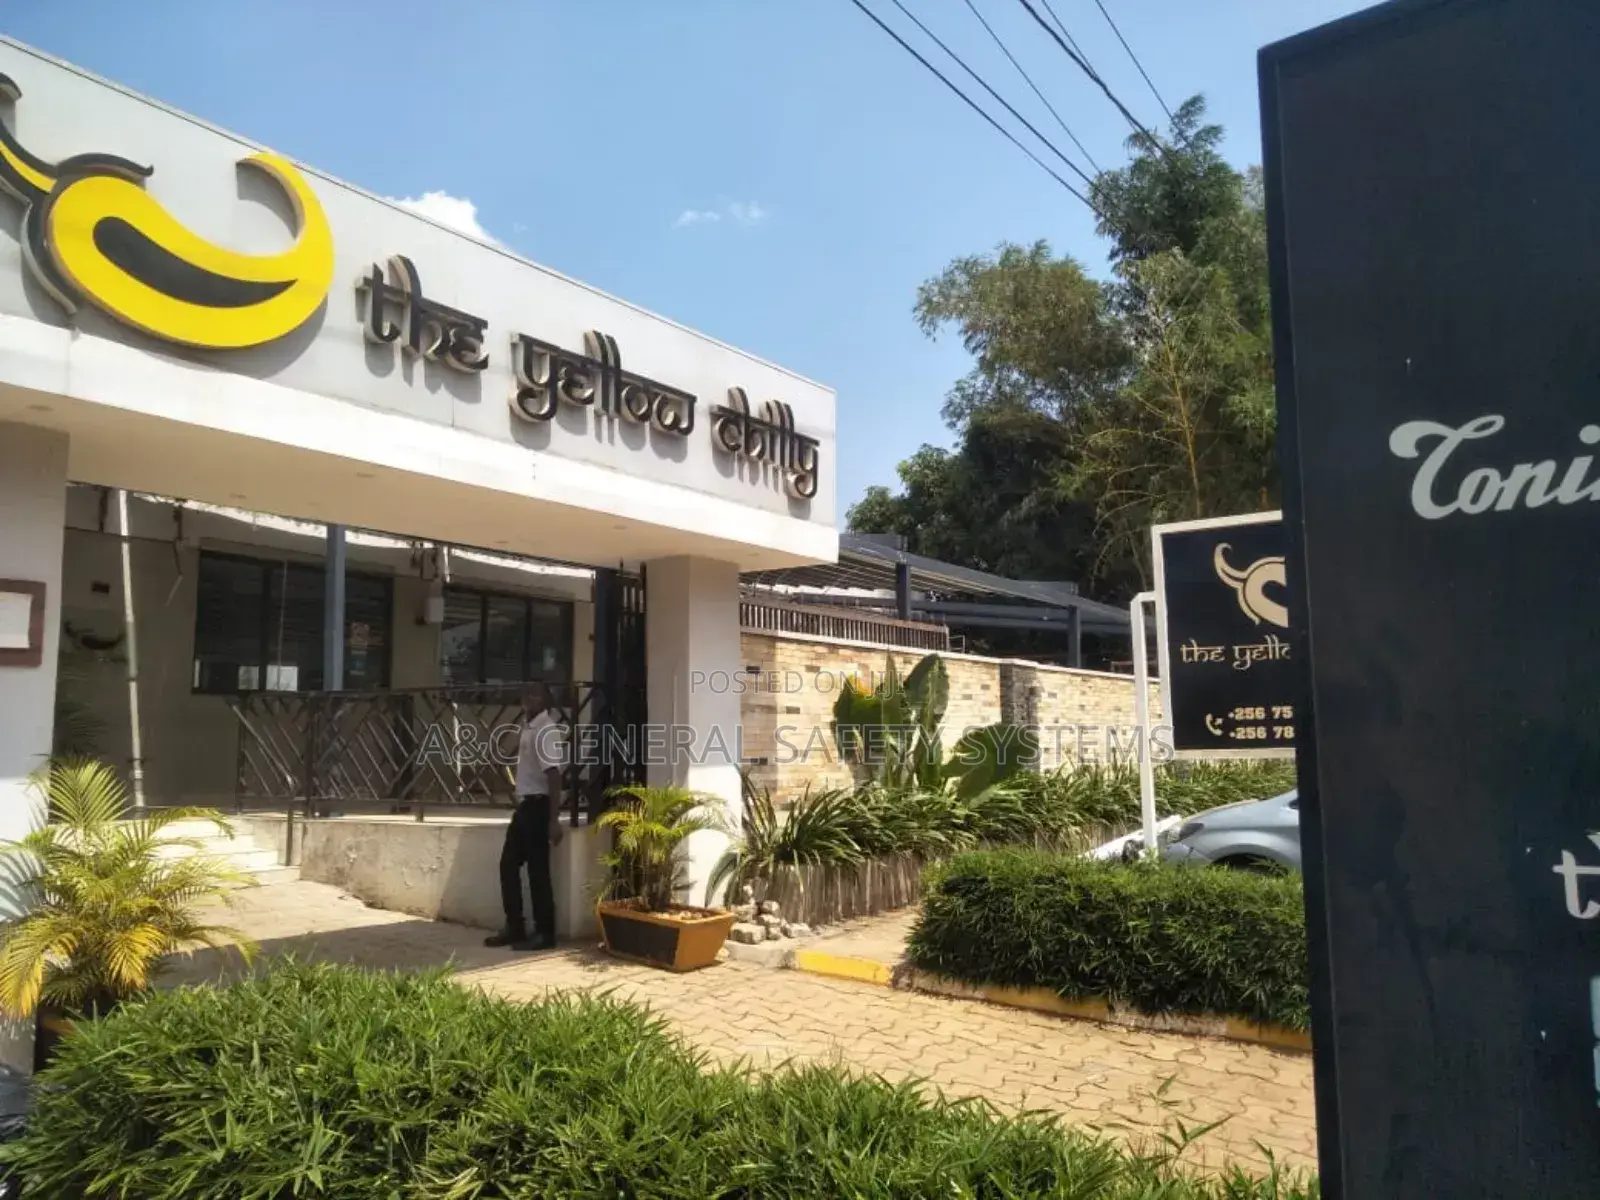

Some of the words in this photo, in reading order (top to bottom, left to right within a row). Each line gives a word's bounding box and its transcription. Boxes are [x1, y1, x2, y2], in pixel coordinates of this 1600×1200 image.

[358, 254, 489, 372] the
[511, 330, 697, 437] yellow
[711, 386, 820, 499] chilly
[1389, 414, 1600, 520] Toni
[1180, 637, 1225, 663] the
